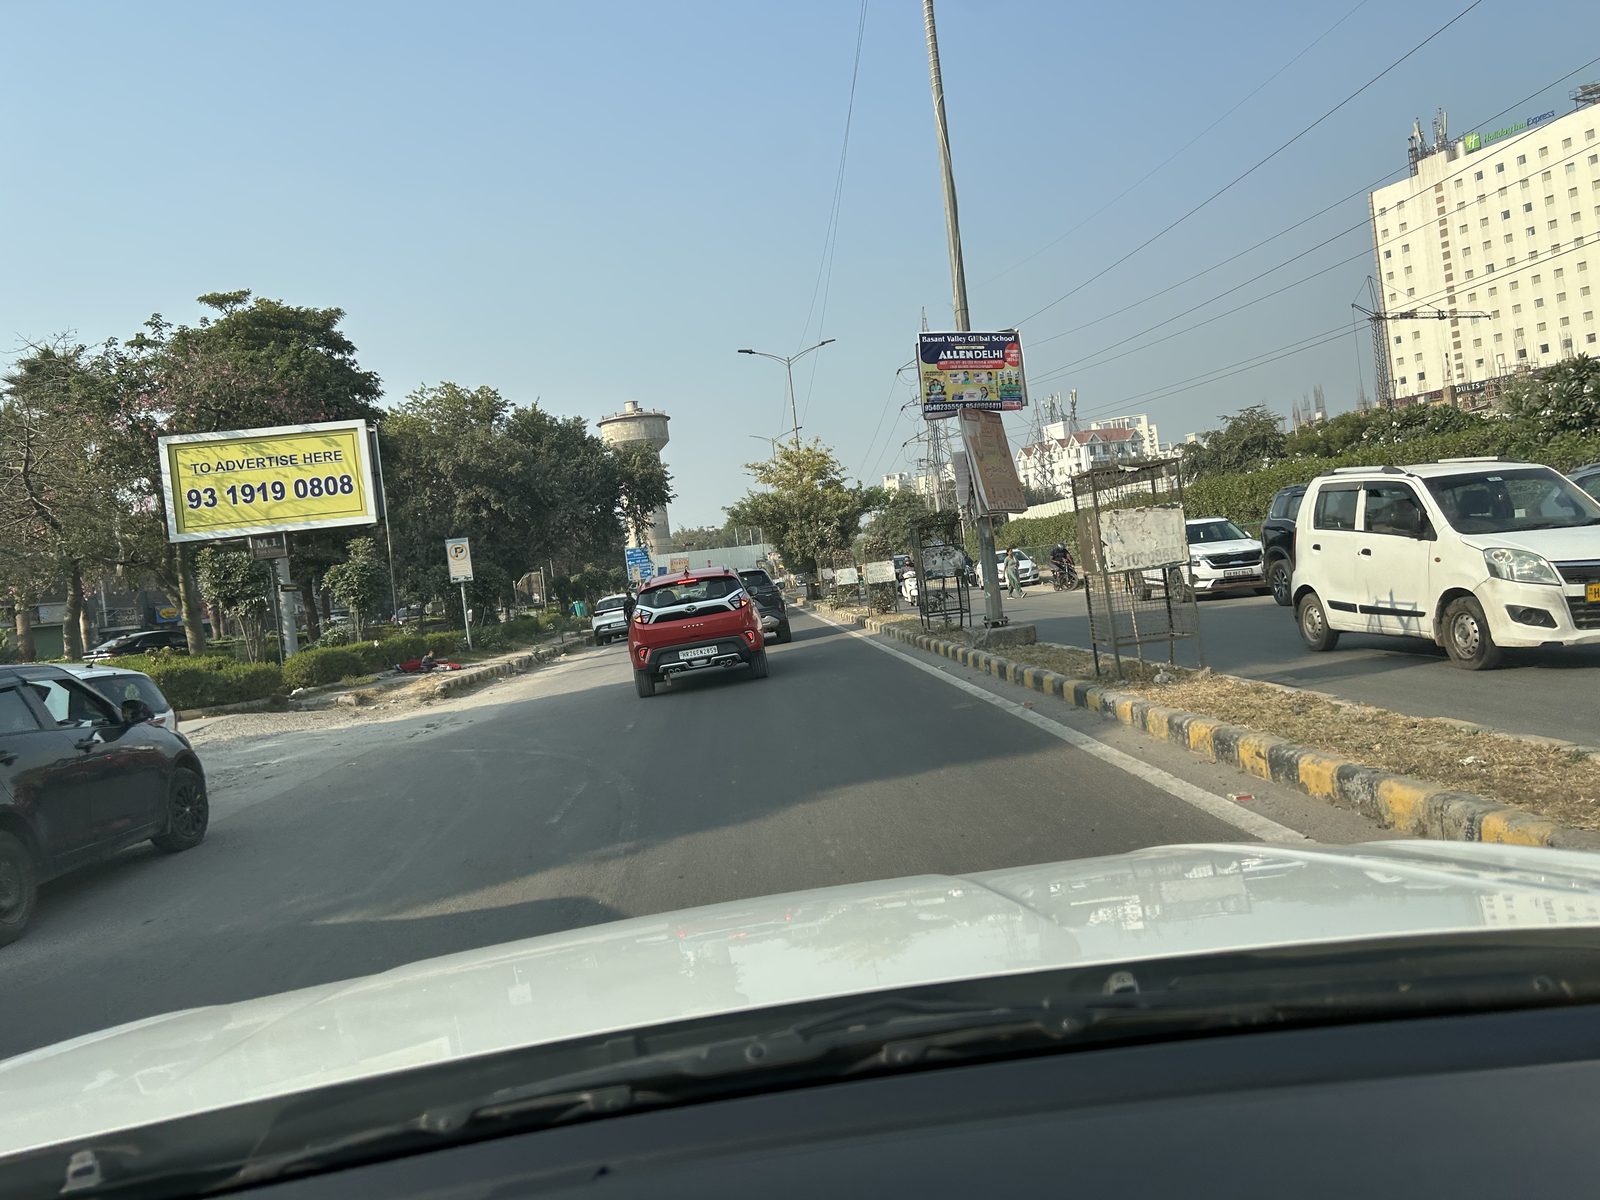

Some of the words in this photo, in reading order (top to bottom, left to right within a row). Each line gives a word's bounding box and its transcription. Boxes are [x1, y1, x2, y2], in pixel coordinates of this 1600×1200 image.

[1527, 110, 1555, 126] Express
[947, 335, 967, 343] Valley
[938, 351, 973, 359] ALLEN
[974, 349, 1003, 359] DELHI
[191, 462, 212, 474] TO
[215, 454, 299, 472] ADVERTISE
[303, 450, 343, 464] HERE
[186, 487, 218, 510] 93
[226, 480, 286, 506] 1919
[293, 474, 354, 499] 0808
